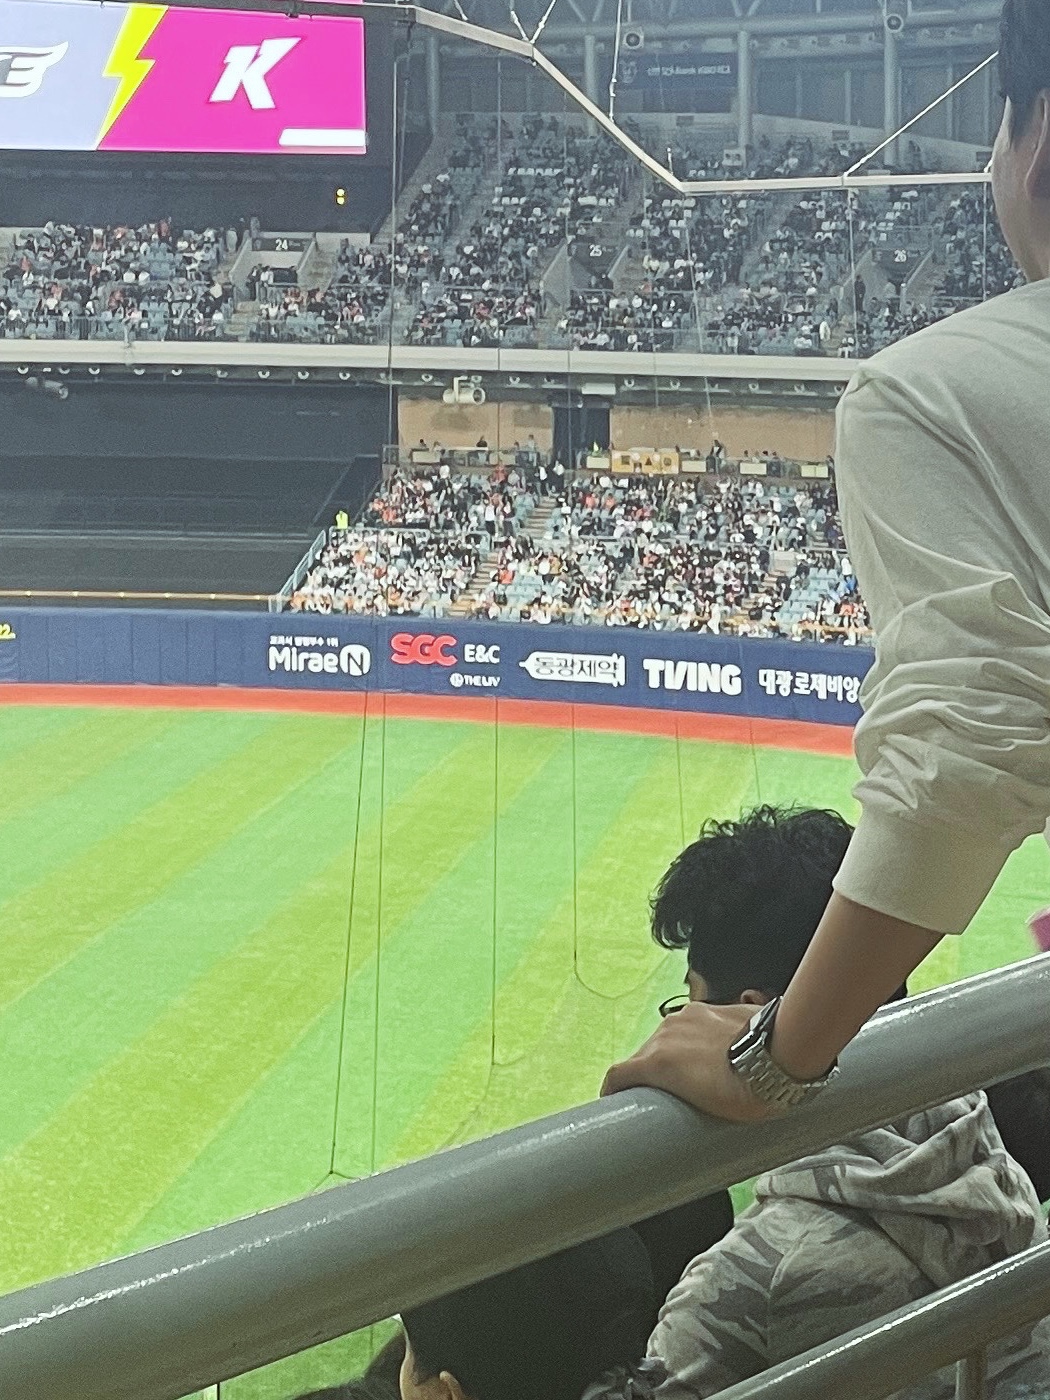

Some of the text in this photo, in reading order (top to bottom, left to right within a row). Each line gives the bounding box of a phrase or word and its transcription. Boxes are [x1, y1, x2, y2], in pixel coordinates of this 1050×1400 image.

[275, 238, 288, 251] 24
[390, 633, 500, 666] SGC E&C
[643, 658, 742, 696] TVING
